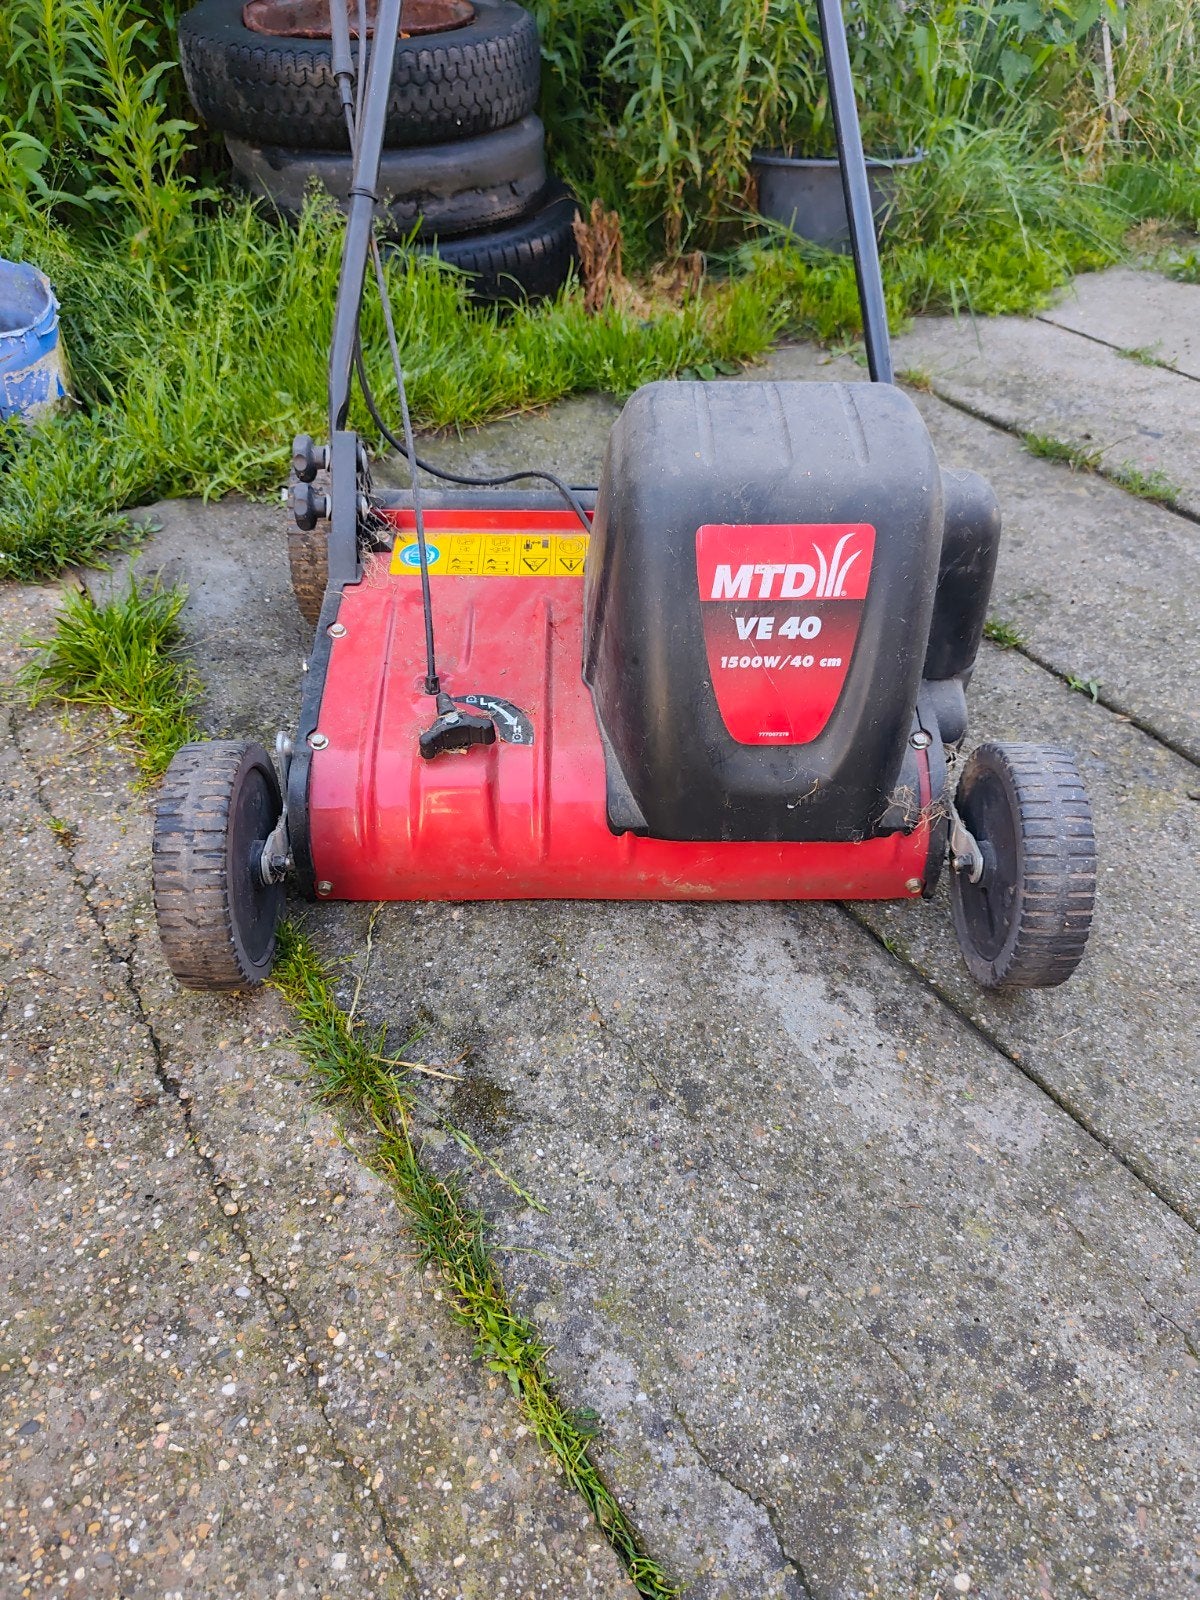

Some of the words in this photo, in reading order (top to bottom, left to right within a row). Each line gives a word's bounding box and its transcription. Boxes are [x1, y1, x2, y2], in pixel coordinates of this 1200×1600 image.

[711, 563, 817, 599] MTD
[735, 616, 775, 640] VE
[778, 616, 822, 640] 40
[720, 655, 815, 670] 1500W/40
[819, 656, 842, 668] cm
